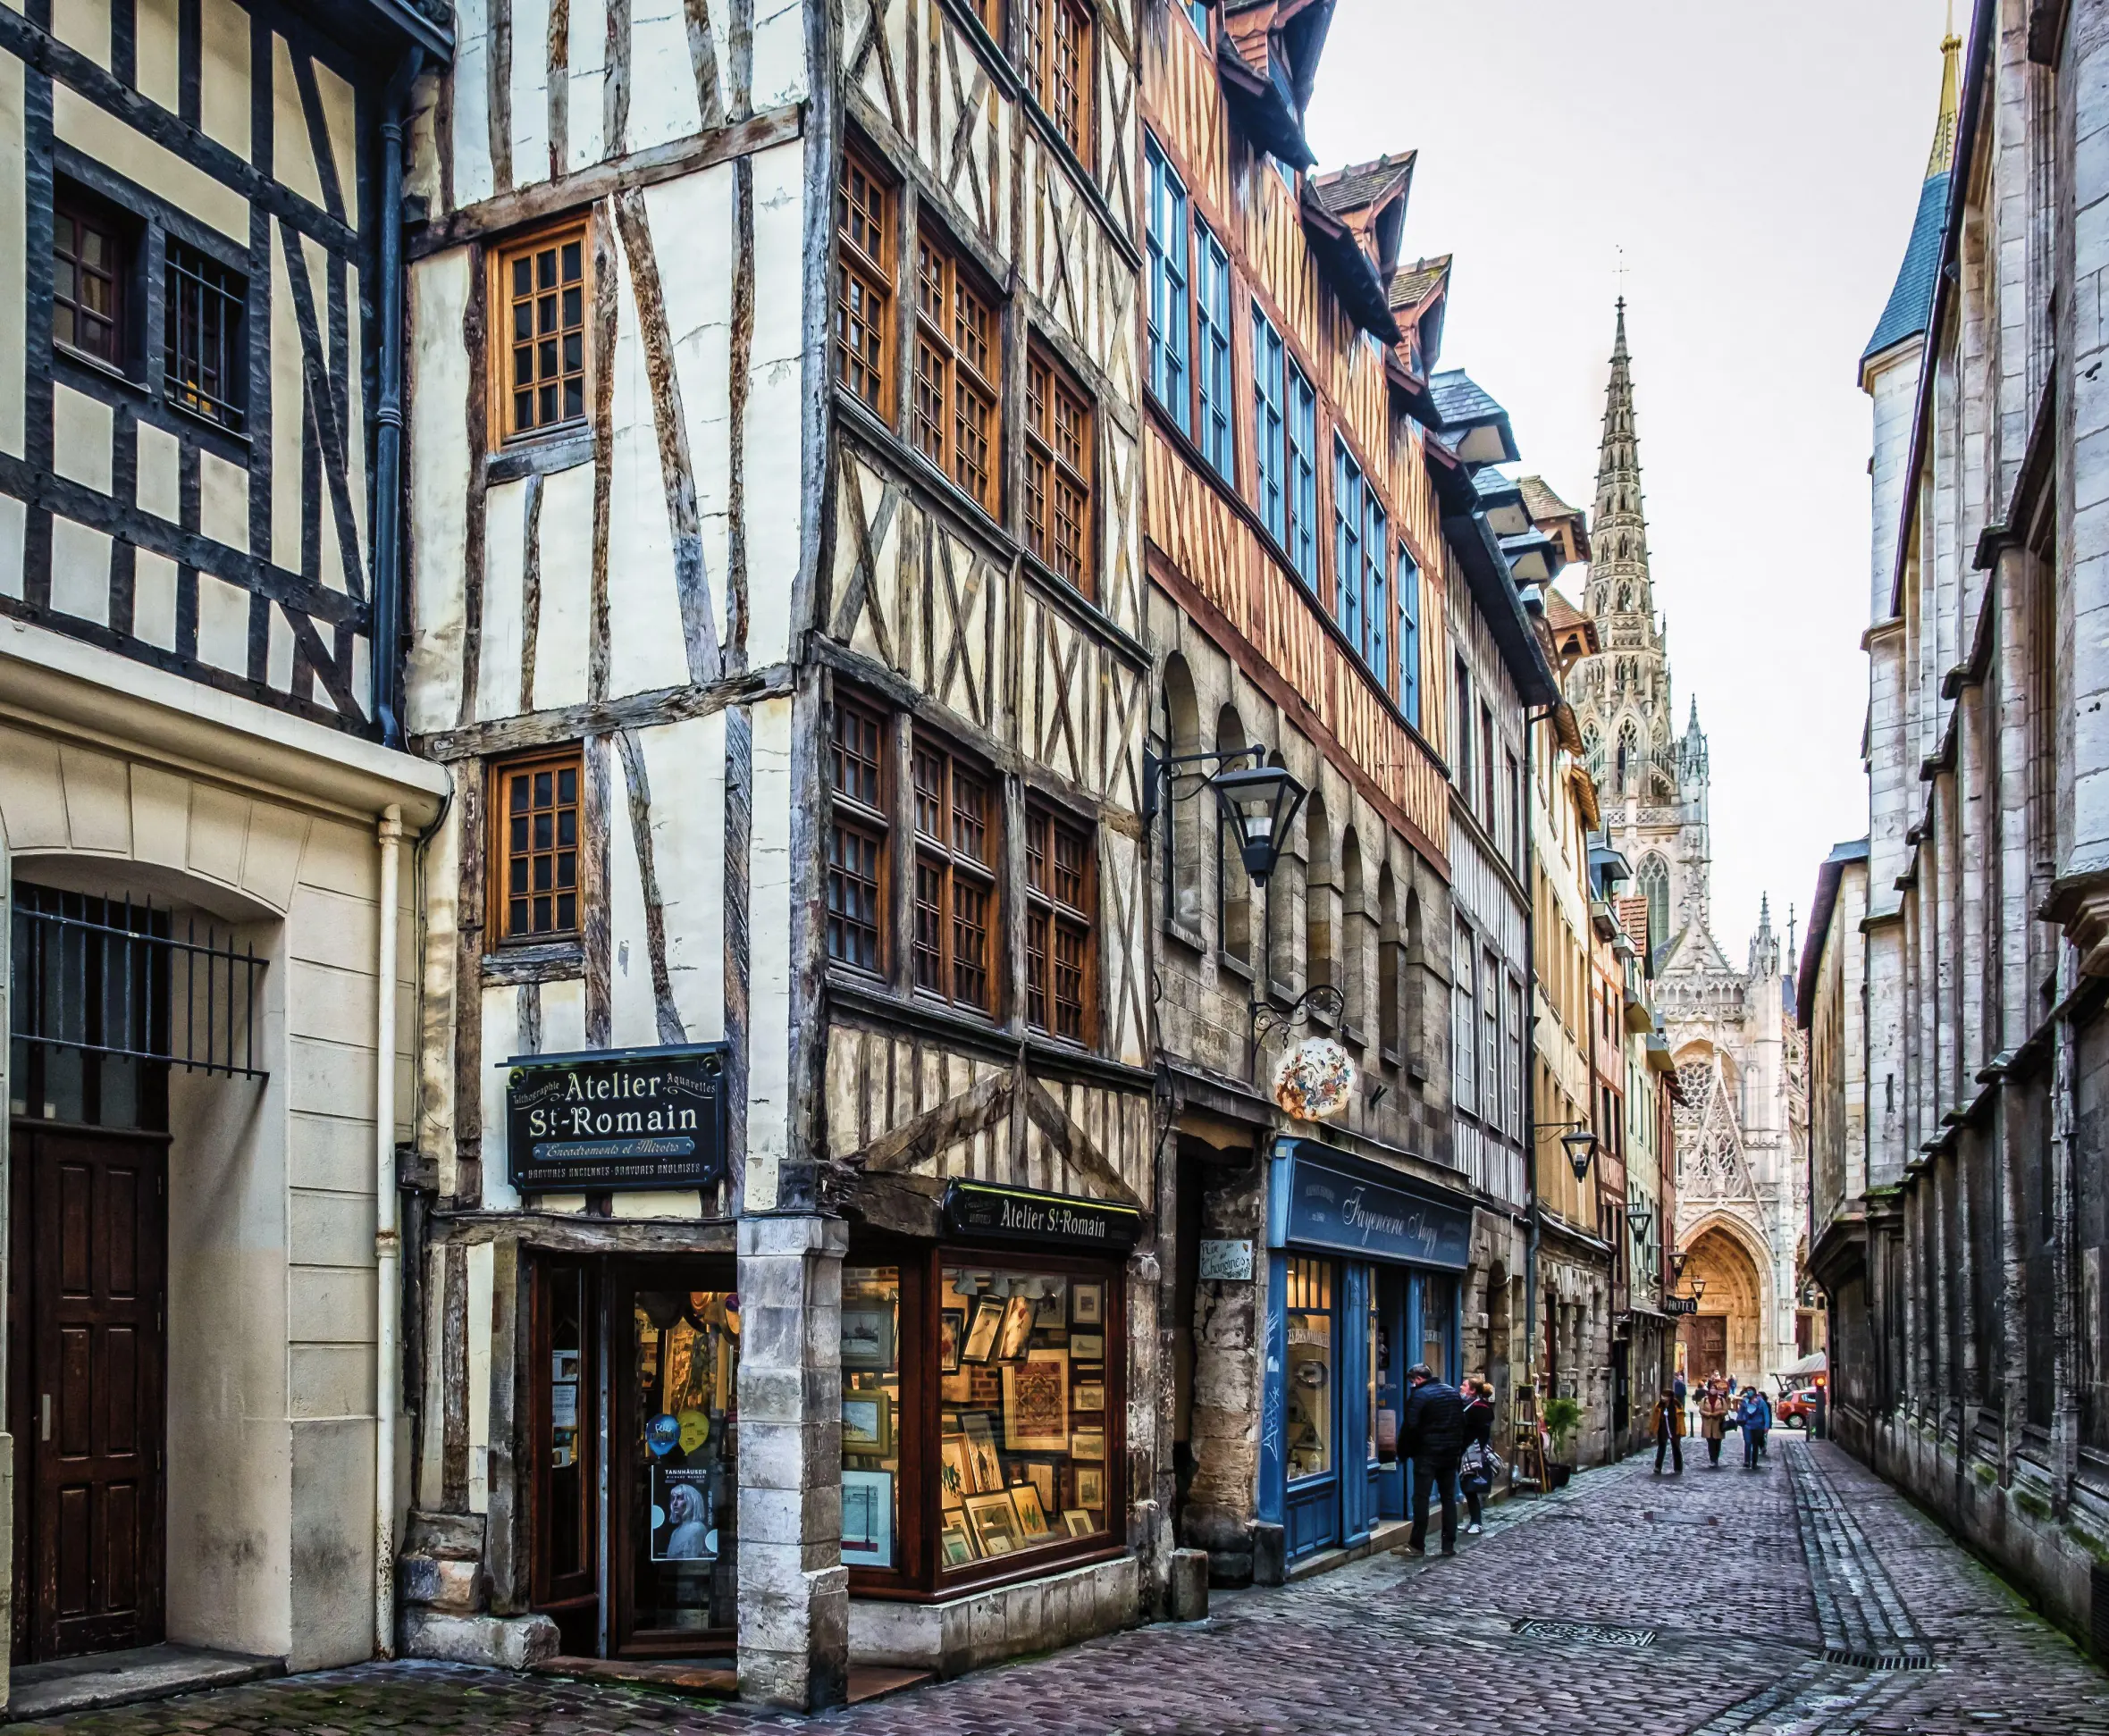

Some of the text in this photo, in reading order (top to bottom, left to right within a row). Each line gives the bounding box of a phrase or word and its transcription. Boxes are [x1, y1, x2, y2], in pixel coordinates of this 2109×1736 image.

[513, 1081, 559, 1104] Lithographie
[565, 1072, 660, 1101] Atelier
[667, 1072, 716, 1093] Aquarelles
[545, 1139, 679, 1158] Encadrements et Miroirs
[1000, 1198, 1045, 1231] Atelier
[1342, 1186, 1438, 1258] Fayencerie Augy
[1201, 1257, 1246, 1278] Chanoines
[1668, 1300, 1696, 1312] HOTEL
